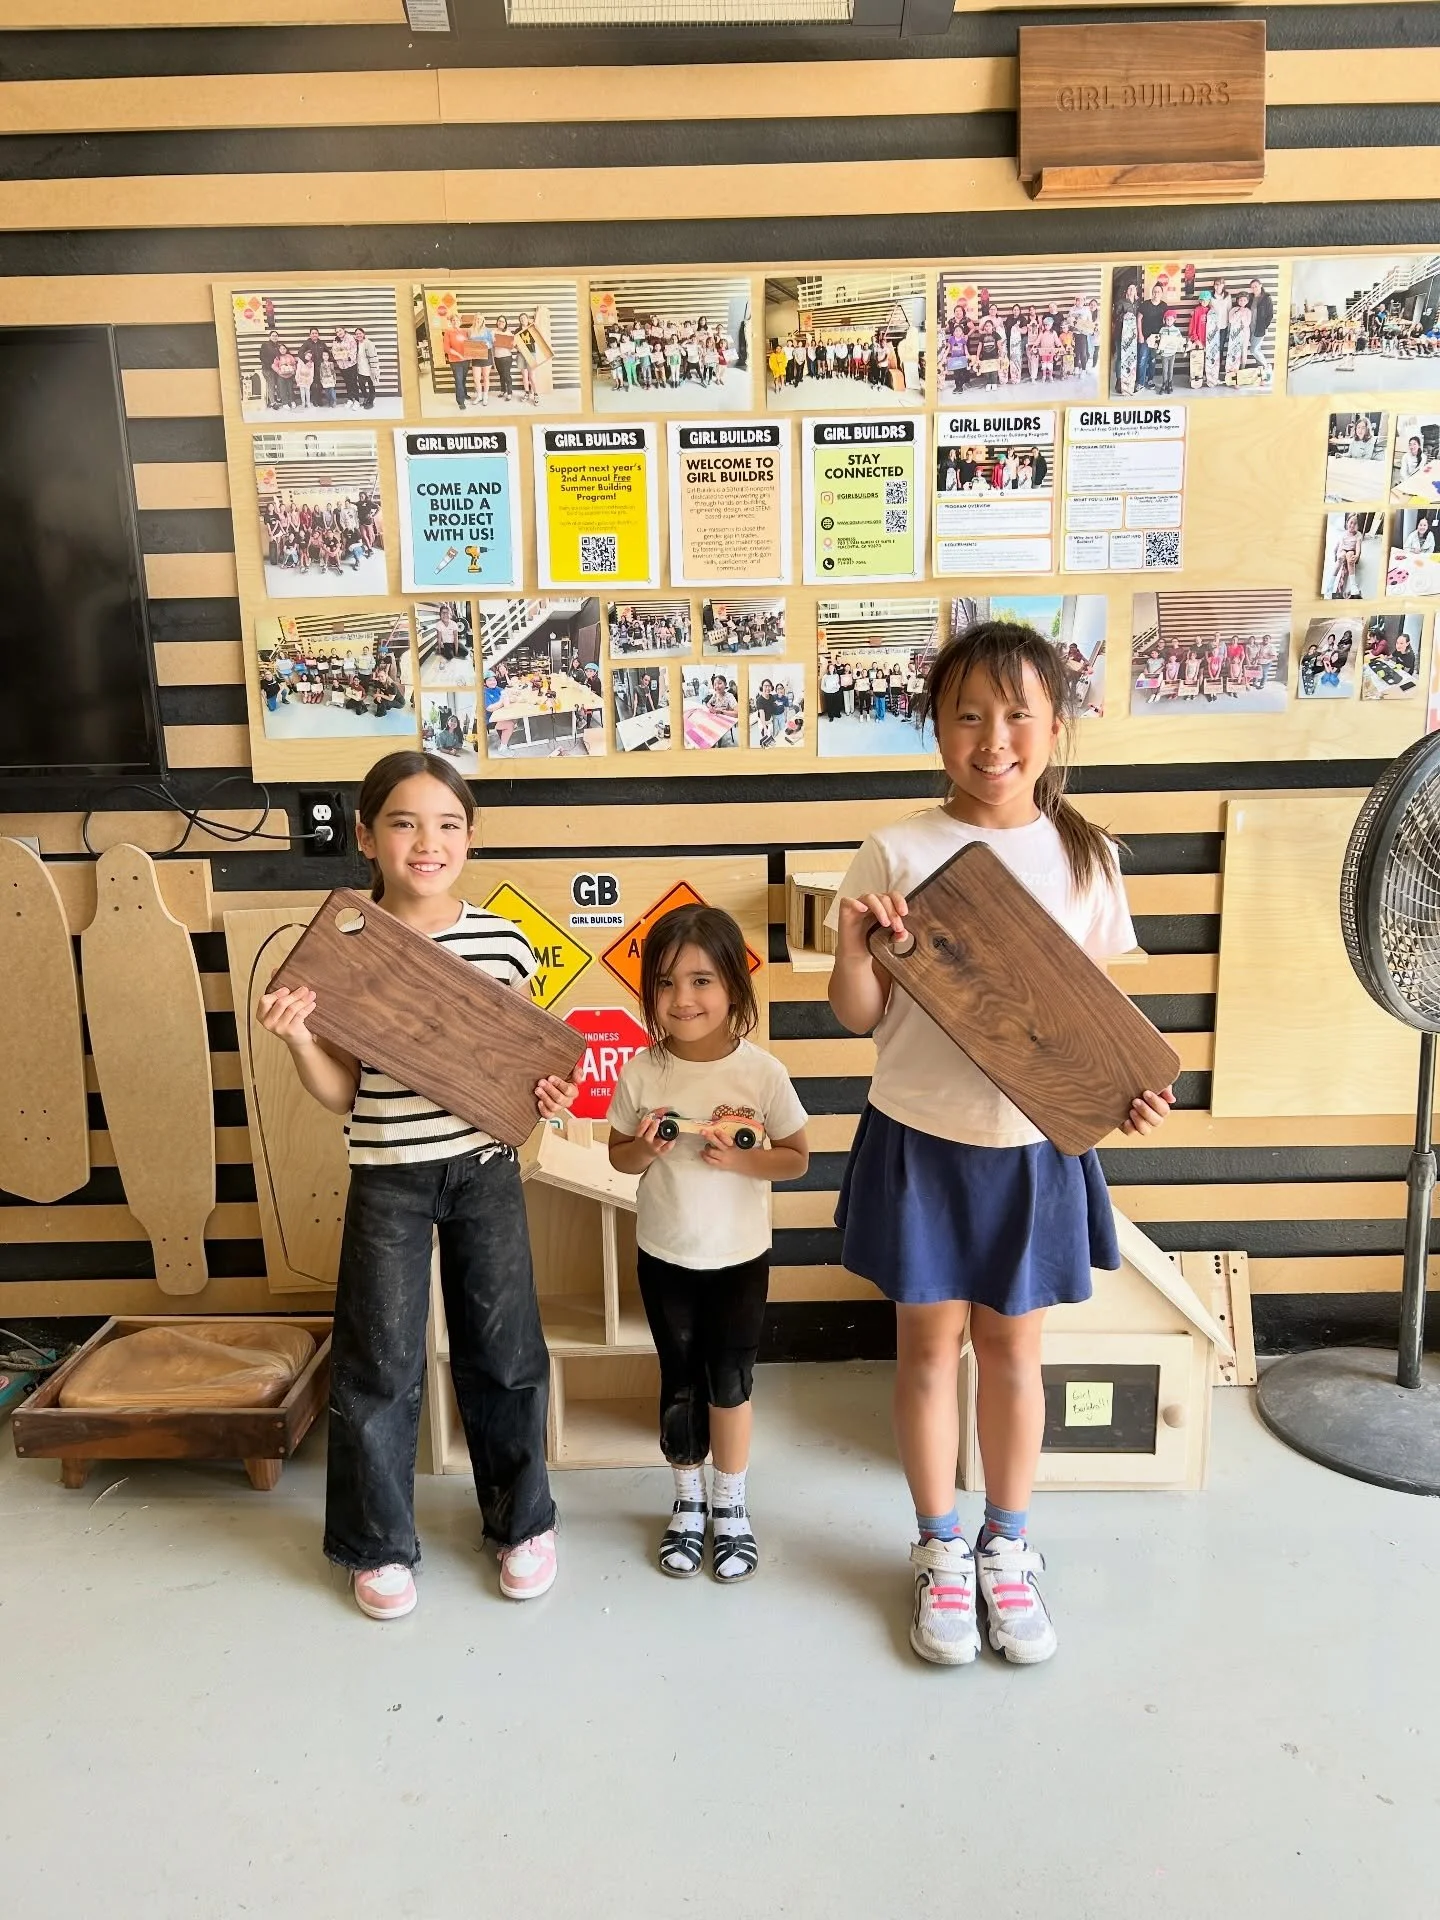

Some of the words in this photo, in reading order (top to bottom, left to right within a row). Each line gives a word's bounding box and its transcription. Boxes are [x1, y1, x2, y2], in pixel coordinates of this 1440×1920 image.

[1057, 86, 1114, 112] GIRL
[1121, 81, 1230, 108] BUILDRS
[1080, 412, 1110, 426] GIRL
[1113, 410, 1171, 425] BUILDRS
[950, 419, 980, 433] GIRL
[983, 417, 1040, 431] BUILDRS
[554, 433, 584, 447] GIRL
[585, 432, 637, 446] BUILDRS
[689, 431, 717, 445] GIRL
[719, 429, 772, 444] BUILDRS
[823, 427, 852, 441] GIRL
[854, 425, 906, 439] BUILDRS
[416, 437, 445, 451] GIRL
[447, 435, 499, 450] BUILDRS
[686, 458, 751, 470] WELCOME
[756, 457, 774, 468] TO
[848, 453, 881, 465] STAY
[549, 465, 586, 474] Support
[613, 463, 642, 473] year's
[825, 466, 904, 479] CONNECTED
[561, 474, 577, 482] 2nd
[580, 474, 610, 482] Annual
[613, 474, 631, 482] Free
[686, 472, 716, 483] GIRL
[720, 470, 774, 482] BUILDRS
[417, 483, 461, 496] COME
[467, 482, 502, 495] AND
[561, 484, 595, 492] Summer
[598, 483, 632, 492] Building
[430, 498, 473, 510] BUILD
[479, 498, 491, 510] A
[576, 493, 616, 502] Program!
[429, 513, 493, 526] PROJECT
[423, 529, 463, 541] WITH
[469, 528, 494, 541] US!
[573, 875, 618, 906] GB
[571, 916, 589, 924] GIRL
[590, 916, 623, 924] BUILDRS
[583, 1033, 620, 1041] INDNESS
[590, 1088, 611, 1097] HERE
